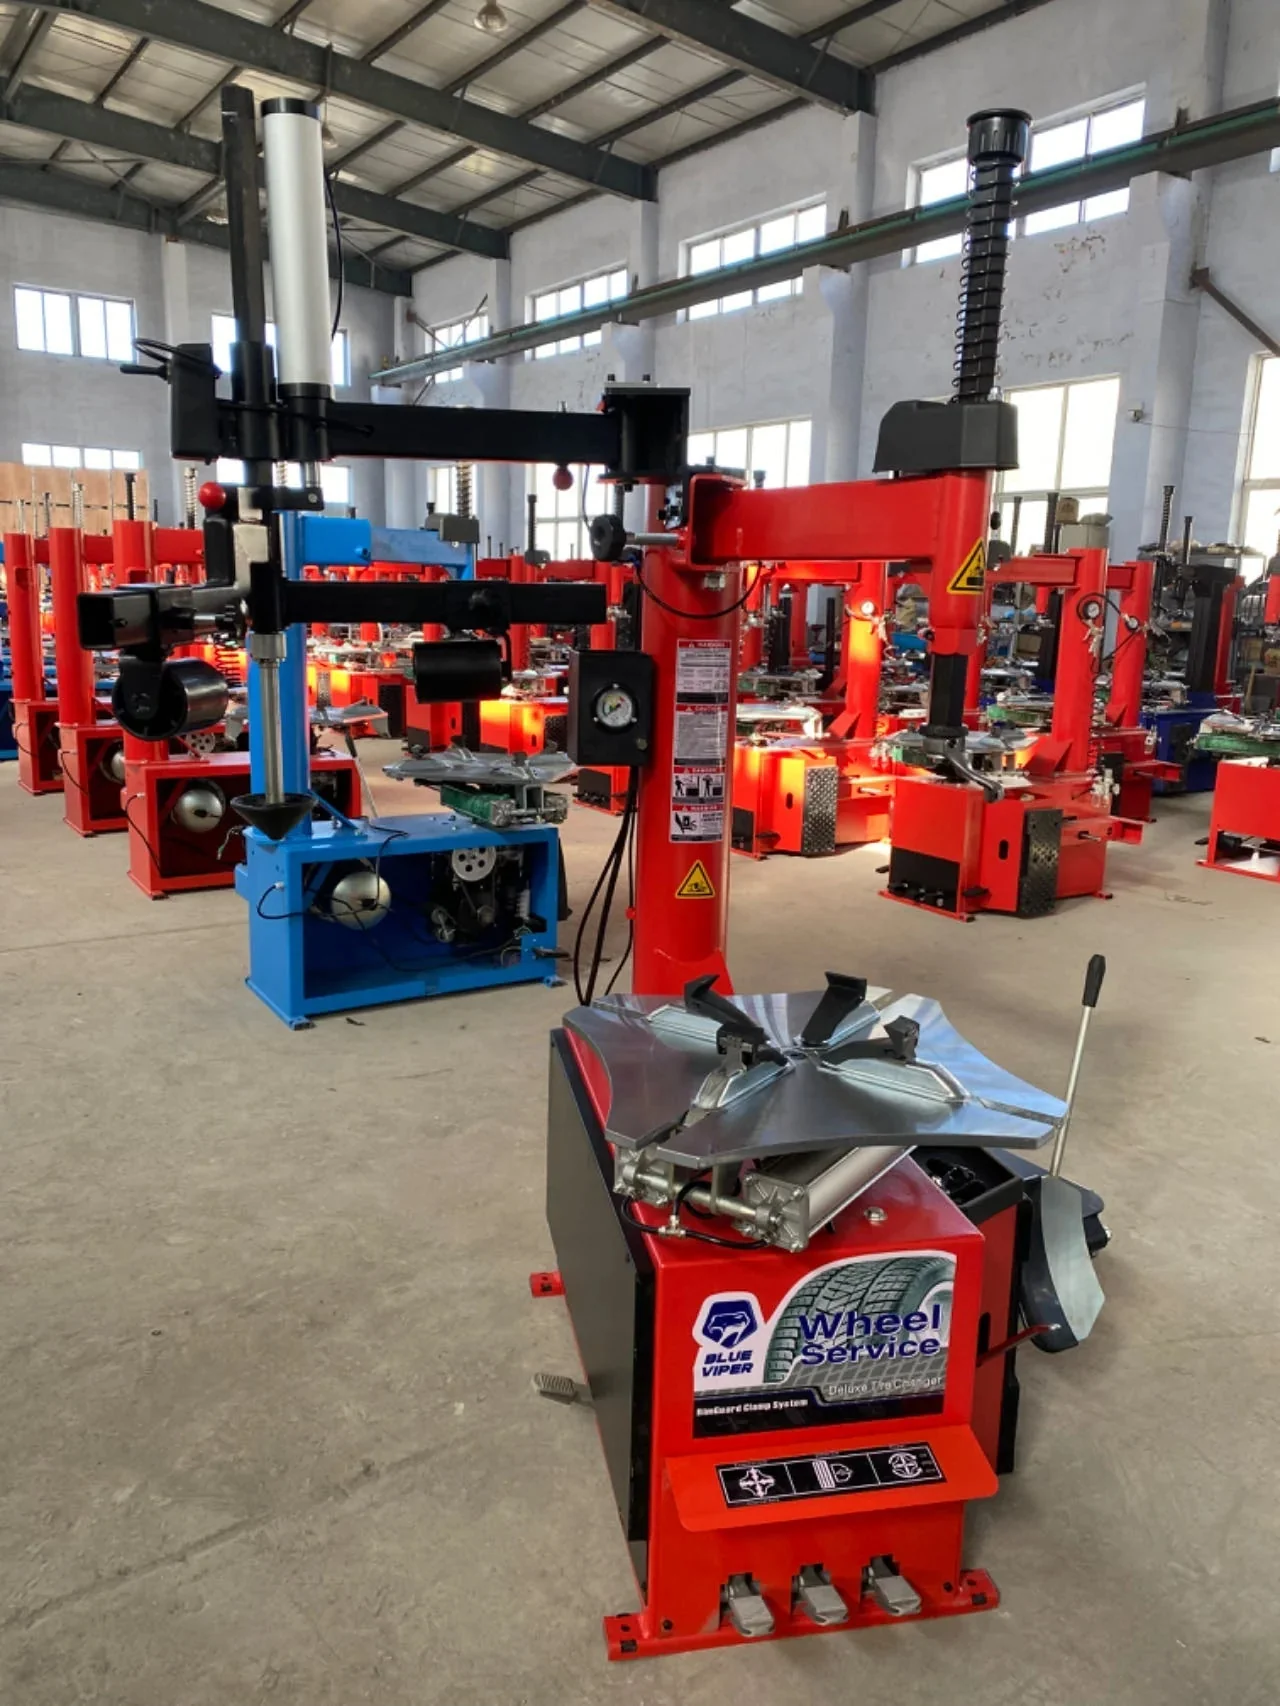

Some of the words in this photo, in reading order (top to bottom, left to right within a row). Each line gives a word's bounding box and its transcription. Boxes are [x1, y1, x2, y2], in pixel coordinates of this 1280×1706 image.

[799, 1304, 940, 1340] Wheel
[704, 1350, 752, 1364] BLUE
[801, 1336, 940, 1365] Service
[702, 1362, 753, 1376] VIPER
[828, 1383, 867, 1395] Deluxe
[773, 1399, 808, 1409] System
